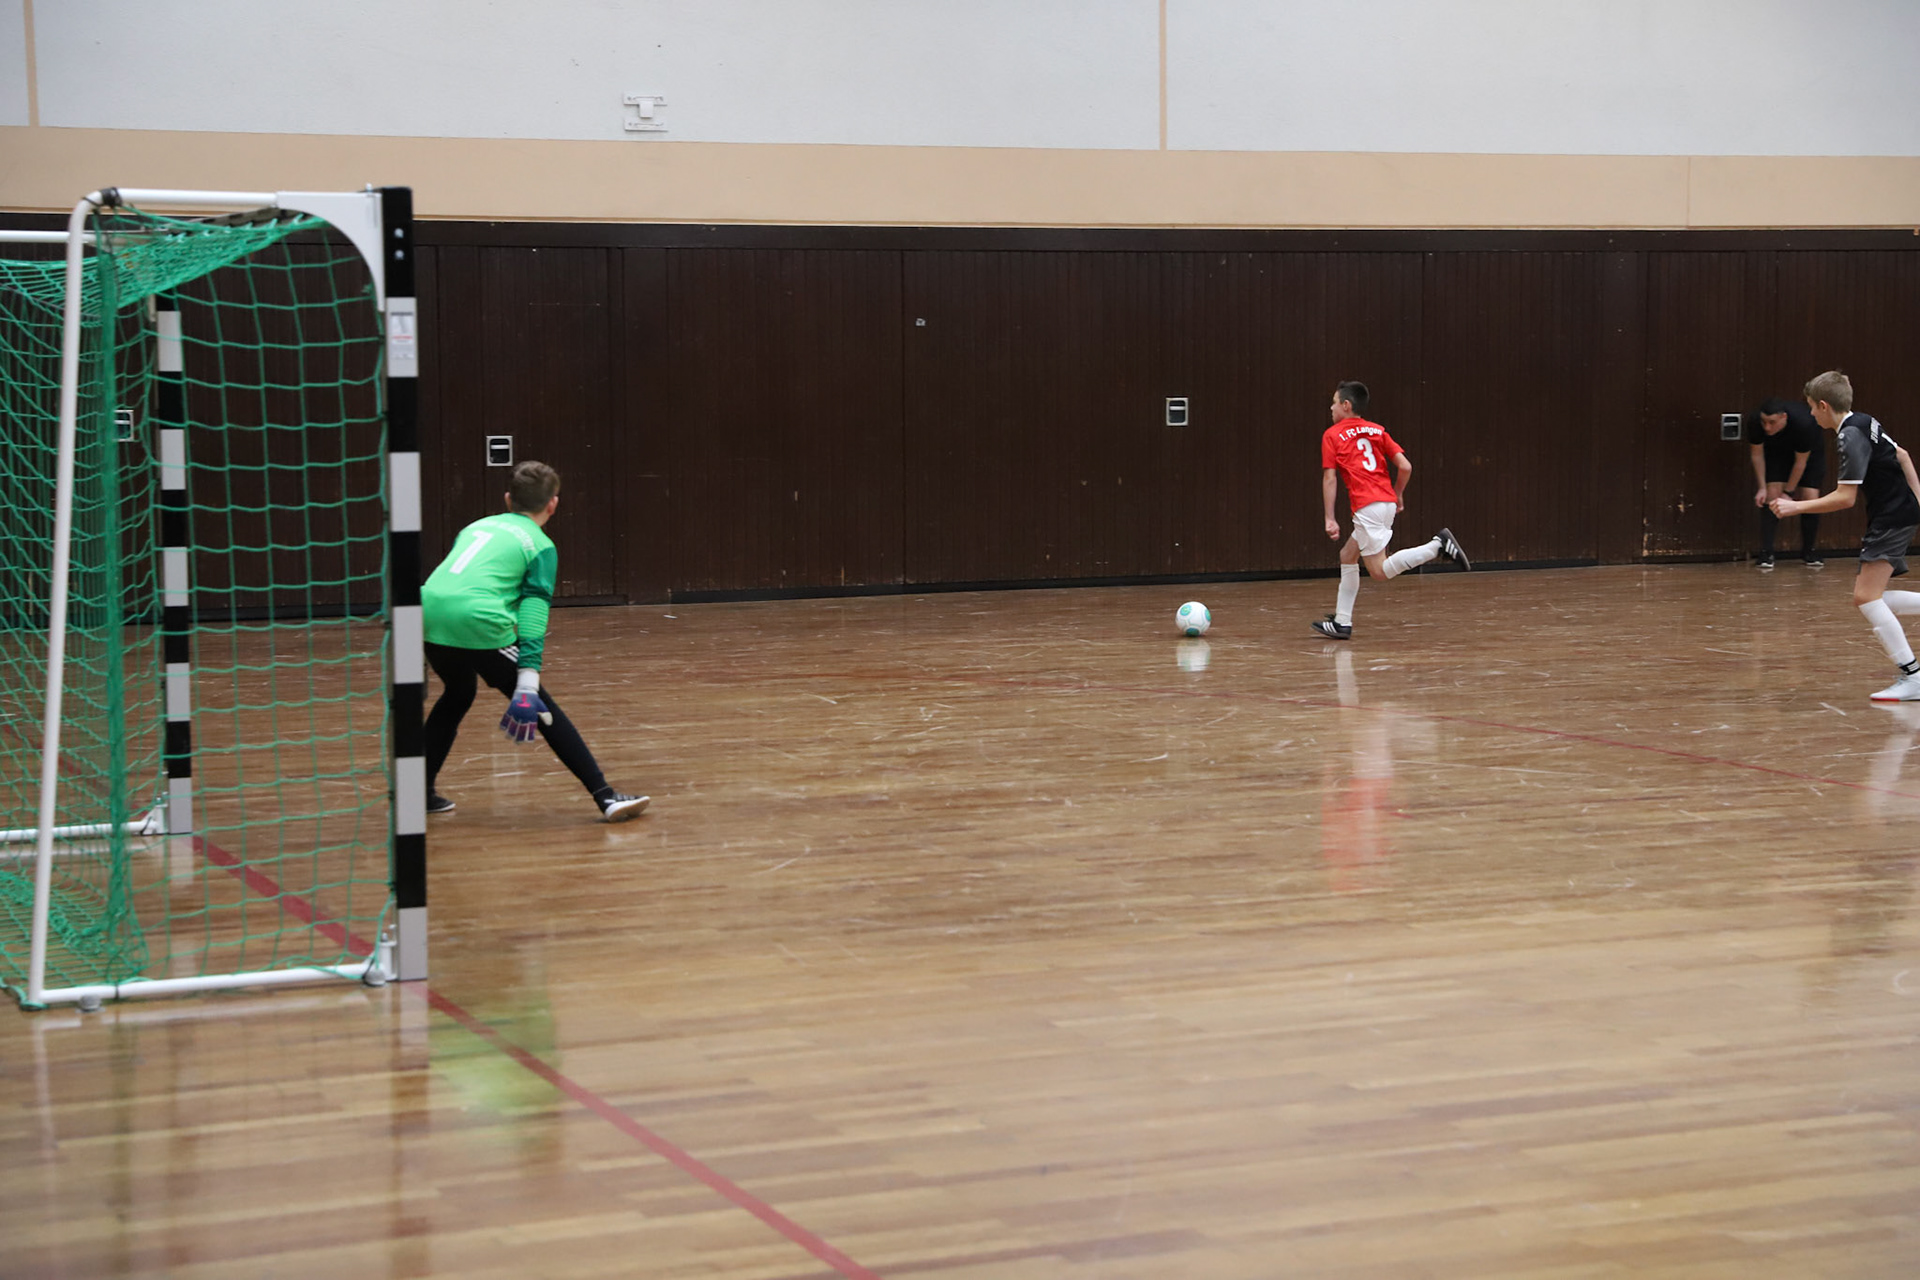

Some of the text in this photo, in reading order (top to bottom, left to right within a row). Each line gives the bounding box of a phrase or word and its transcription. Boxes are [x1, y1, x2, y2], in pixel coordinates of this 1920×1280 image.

[1339, 426, 1382, 441] 1. FC Langen
[1357, 438, 1377, 471] 3
[449, 530, 494, 575] 1
